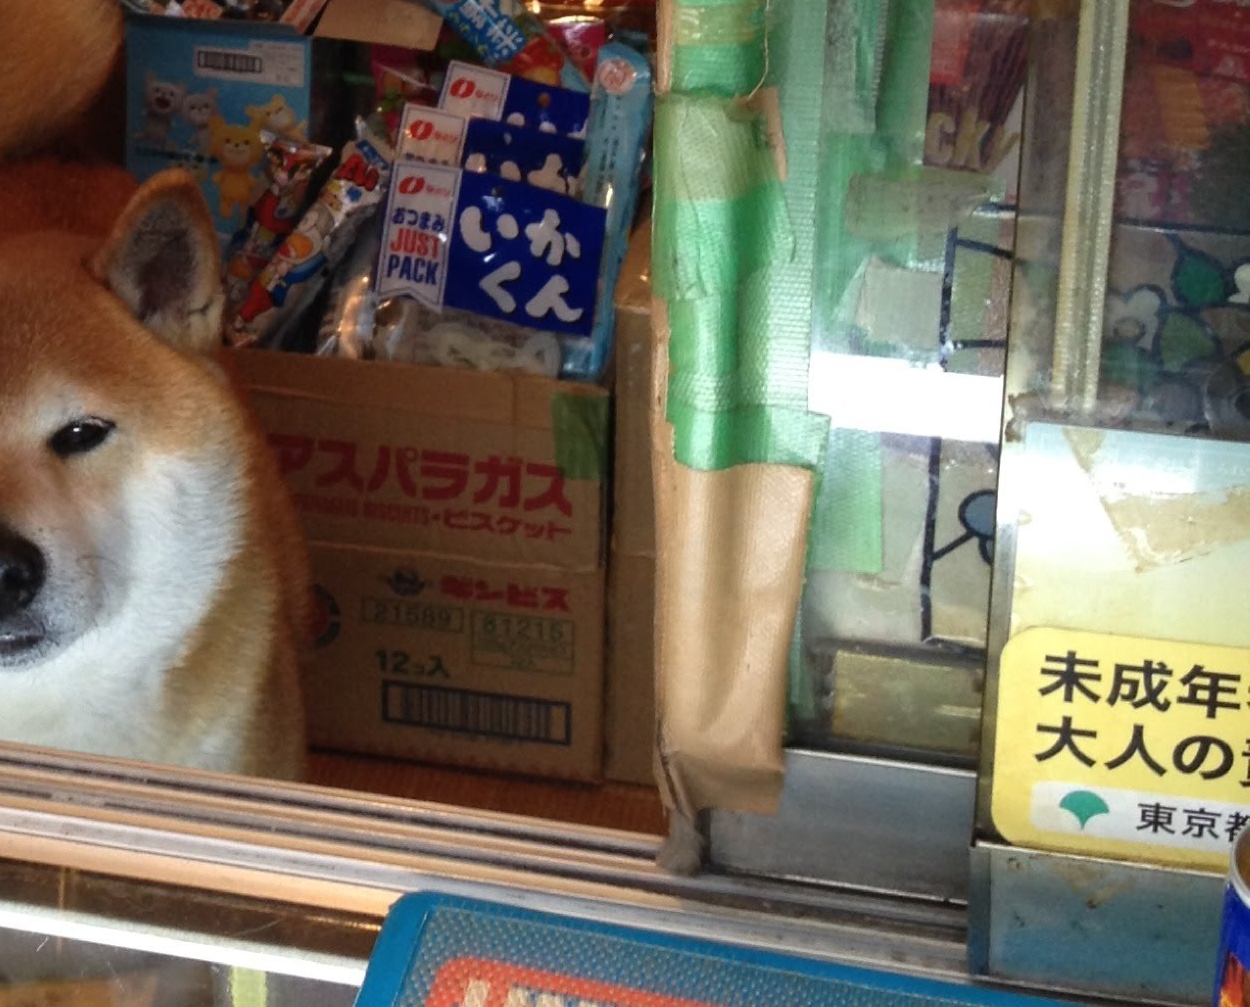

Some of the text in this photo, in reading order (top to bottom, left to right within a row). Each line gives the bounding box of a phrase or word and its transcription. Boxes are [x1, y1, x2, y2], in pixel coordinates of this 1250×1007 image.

[390, 227, 443, 260] JUST
[392, 206, 446, 233] おつまみ
[459, 204, 582, 267] いか
[387, 254, 440, 285] PACK
[477, 259, 585, 324] くん
[267, 432, 573, 518] アスパラガス
[443, 510, 573, 541] ビスケット
[375, 649, 451, 680] 12コ入
[1038, 650, 1250, 720] 未成年
[1035, 715, 1250, 788] 大人の
